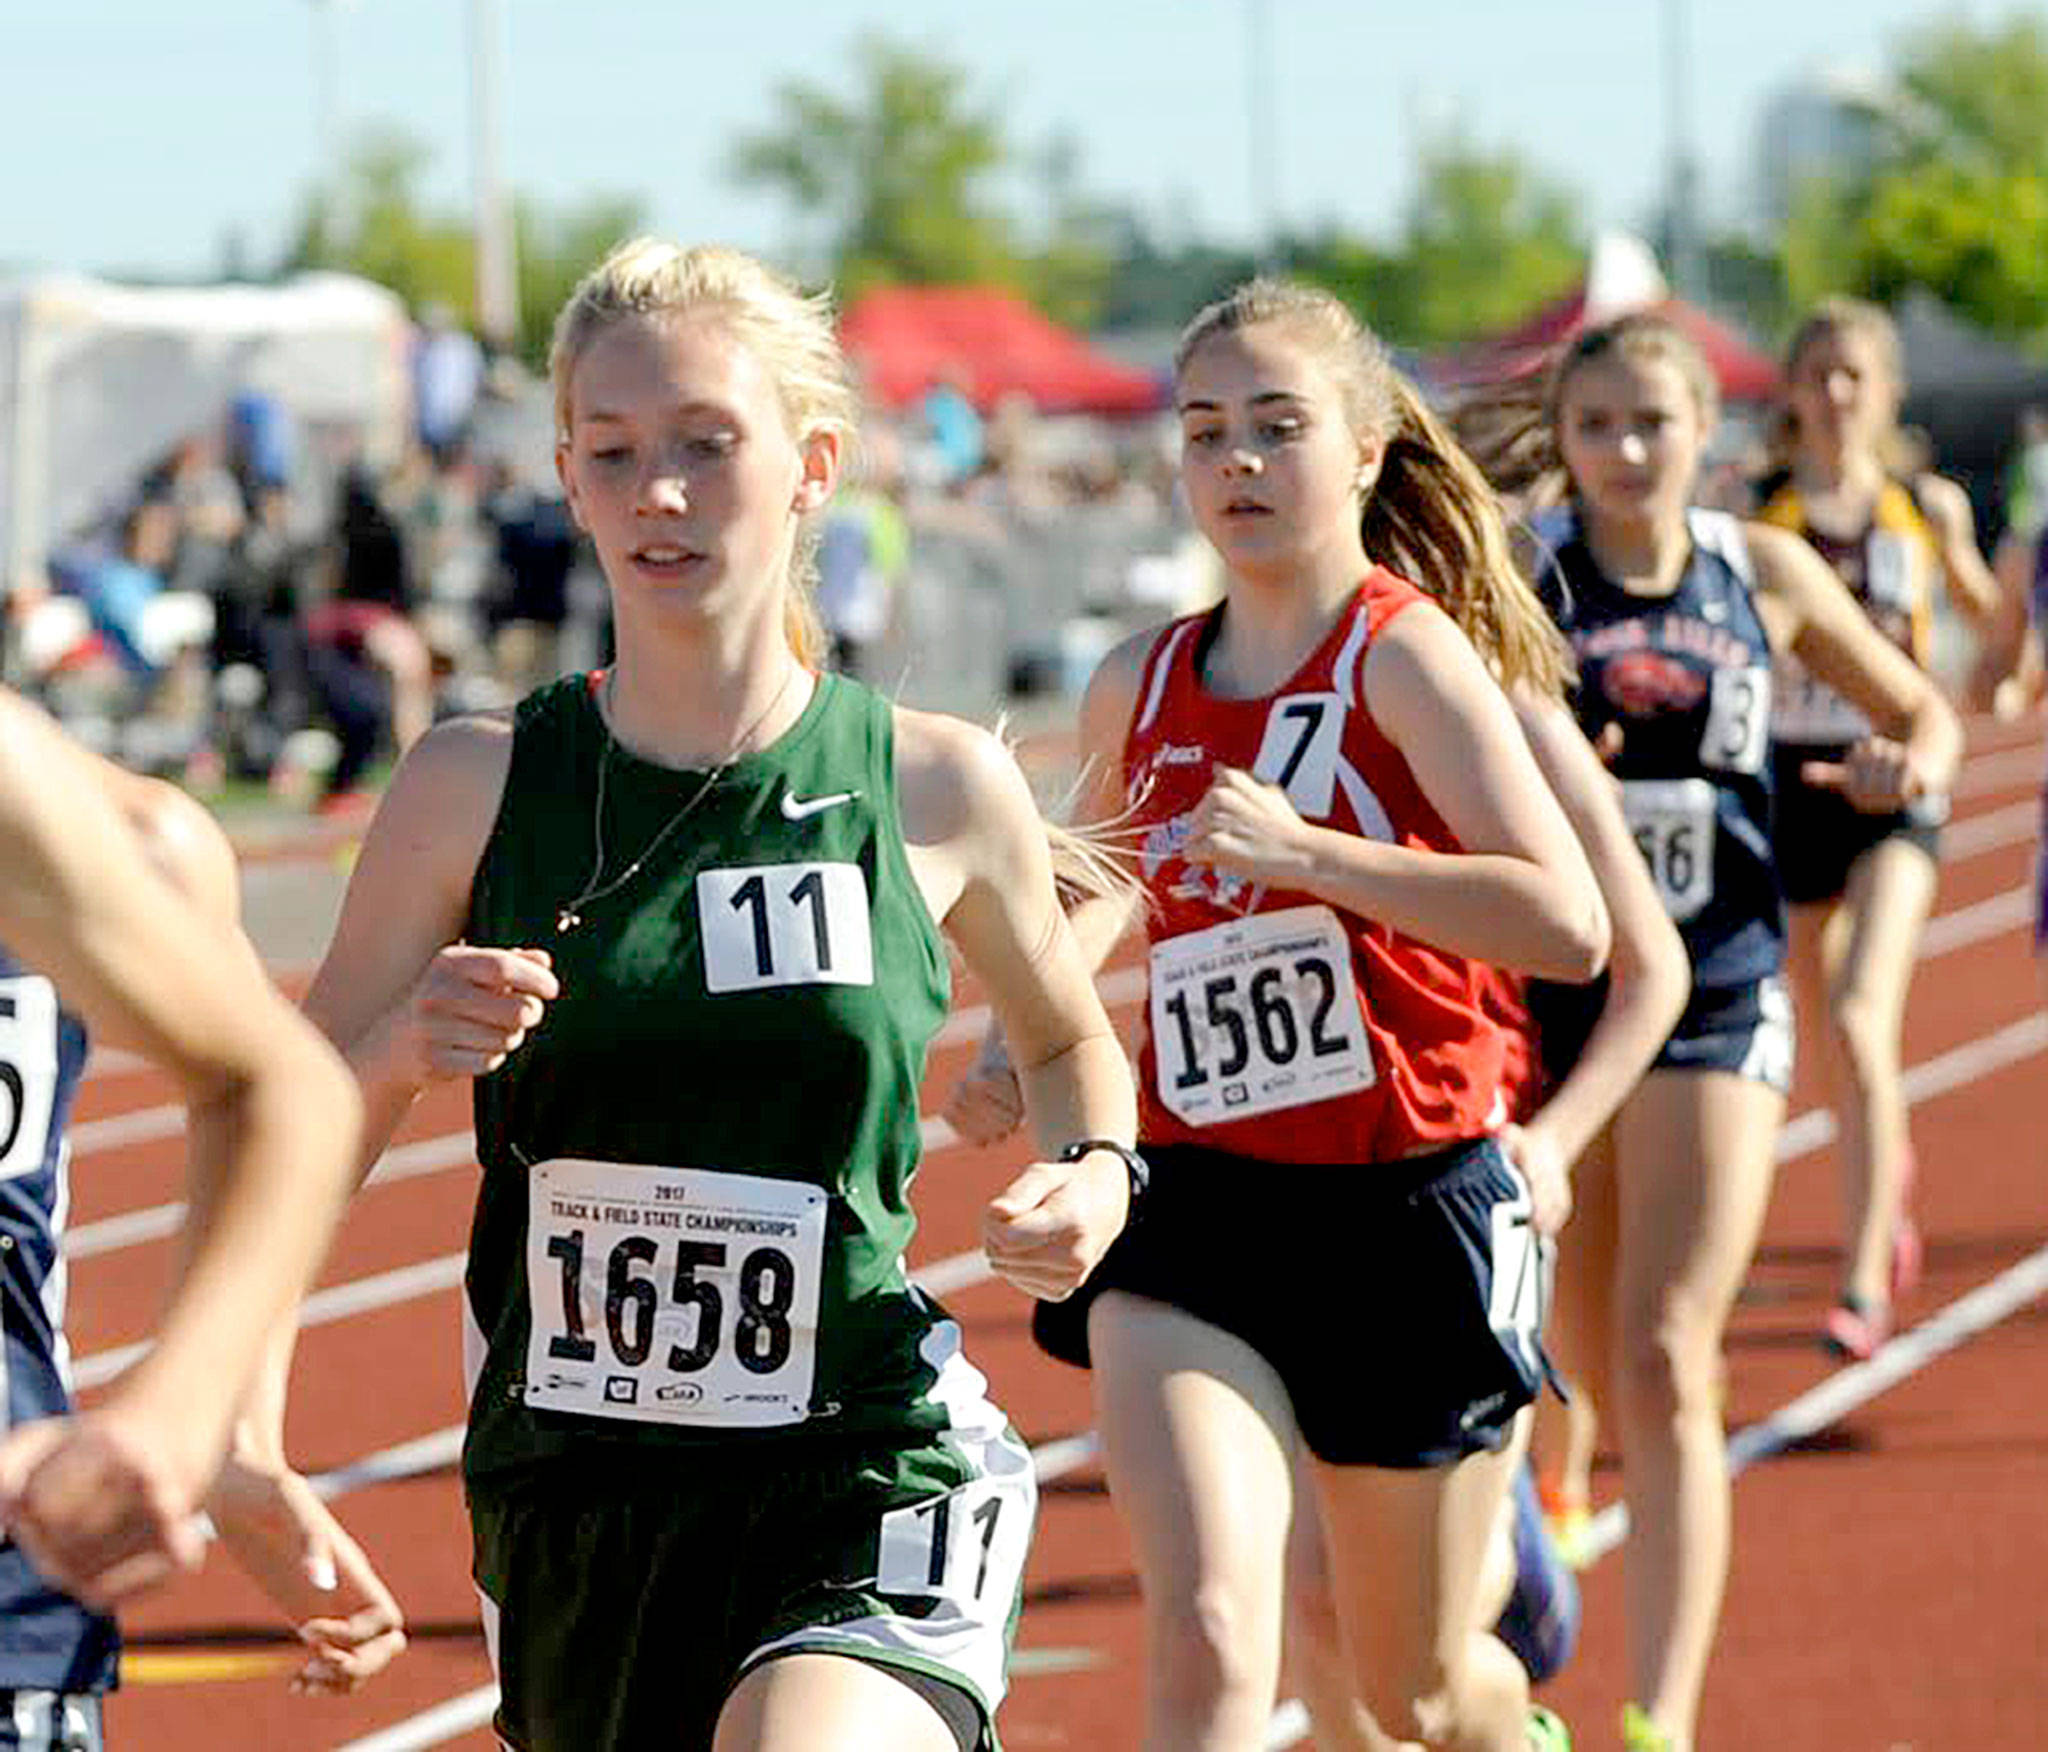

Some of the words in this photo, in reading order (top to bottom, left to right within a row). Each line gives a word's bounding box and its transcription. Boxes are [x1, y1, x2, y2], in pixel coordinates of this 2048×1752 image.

[1279, 702, 1325, 789] 7
[1723, 681, 1754, 758] 3
[729, 871, 832, 976] 11
[1166, 957, 1350, 1090] 1562
[551, 1201, 588, 1219] TRACK
[591, 1206, 599, 1221] &
[604, 1207, 640, 1226] FIELD
[643, 1210, 680, 1229] STATE
[685, 1213, 798, 1238] CHAMPIONSHIPS
[547, 1230, 795, 1375] 1658
[915, 1496, 1003, 1600] 11
